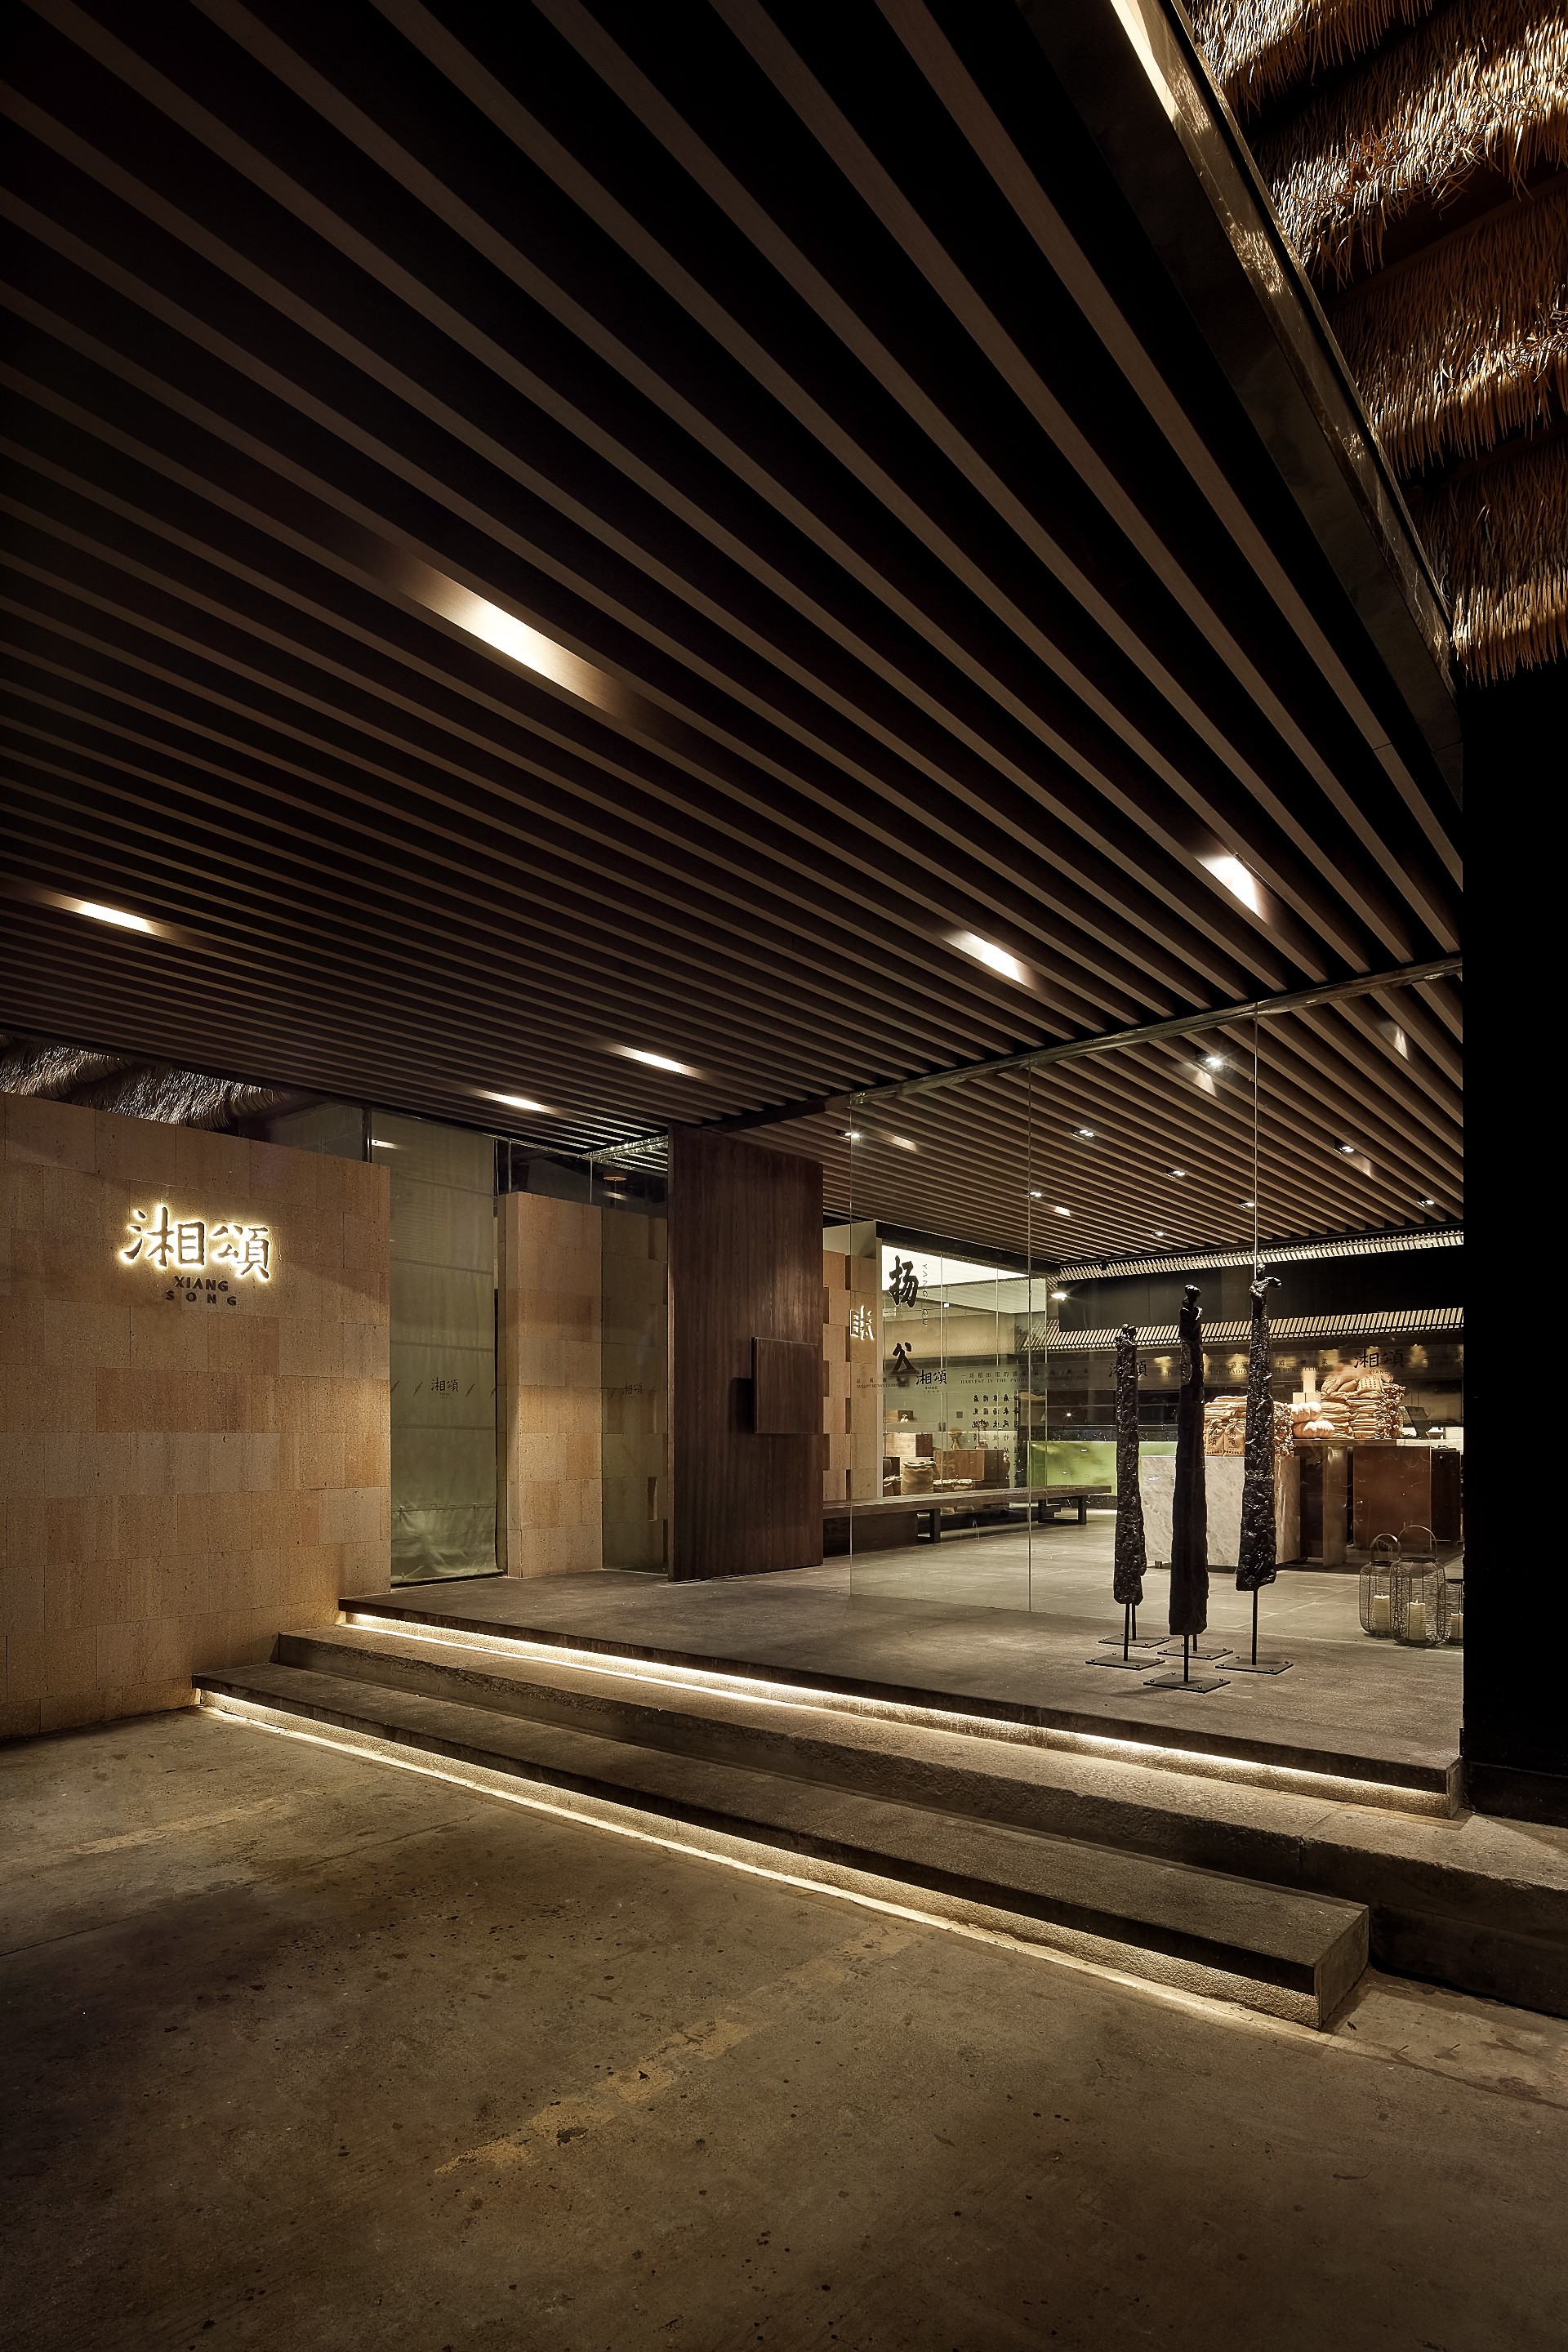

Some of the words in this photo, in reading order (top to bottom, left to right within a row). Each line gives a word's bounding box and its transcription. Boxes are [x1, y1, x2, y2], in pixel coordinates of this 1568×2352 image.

[123, 1206, 270, 1280] 湘頌
[173, 1276, 229, 1292] XIANG
[165, 1290, 237, 1306] SONG
[921, 1307, 929, 1325] GU
[915, 1369, 947, 1385] 湘頌
